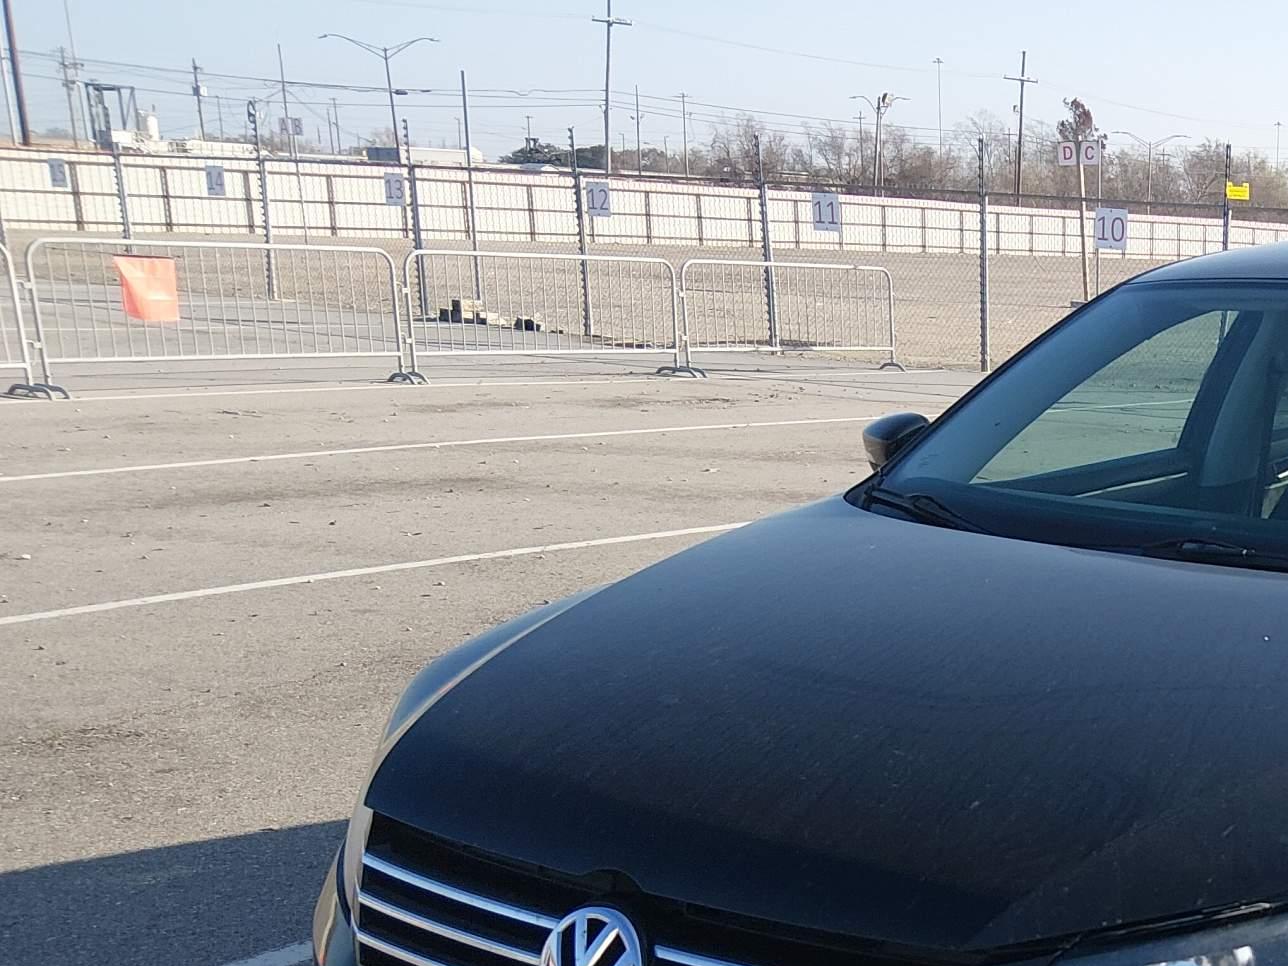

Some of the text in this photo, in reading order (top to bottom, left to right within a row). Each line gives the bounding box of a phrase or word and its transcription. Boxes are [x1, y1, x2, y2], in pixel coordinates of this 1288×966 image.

[279, 119, 289, 134] A
[1063, 145, 1095, 161] D C
[206, 170, 225, 191] 14
[385, 179, 404, 200] 13
[587, 188, 609, 211] 12
[814, 200, 838, 225] 11
[1097, 215, 1126, 242] 10
